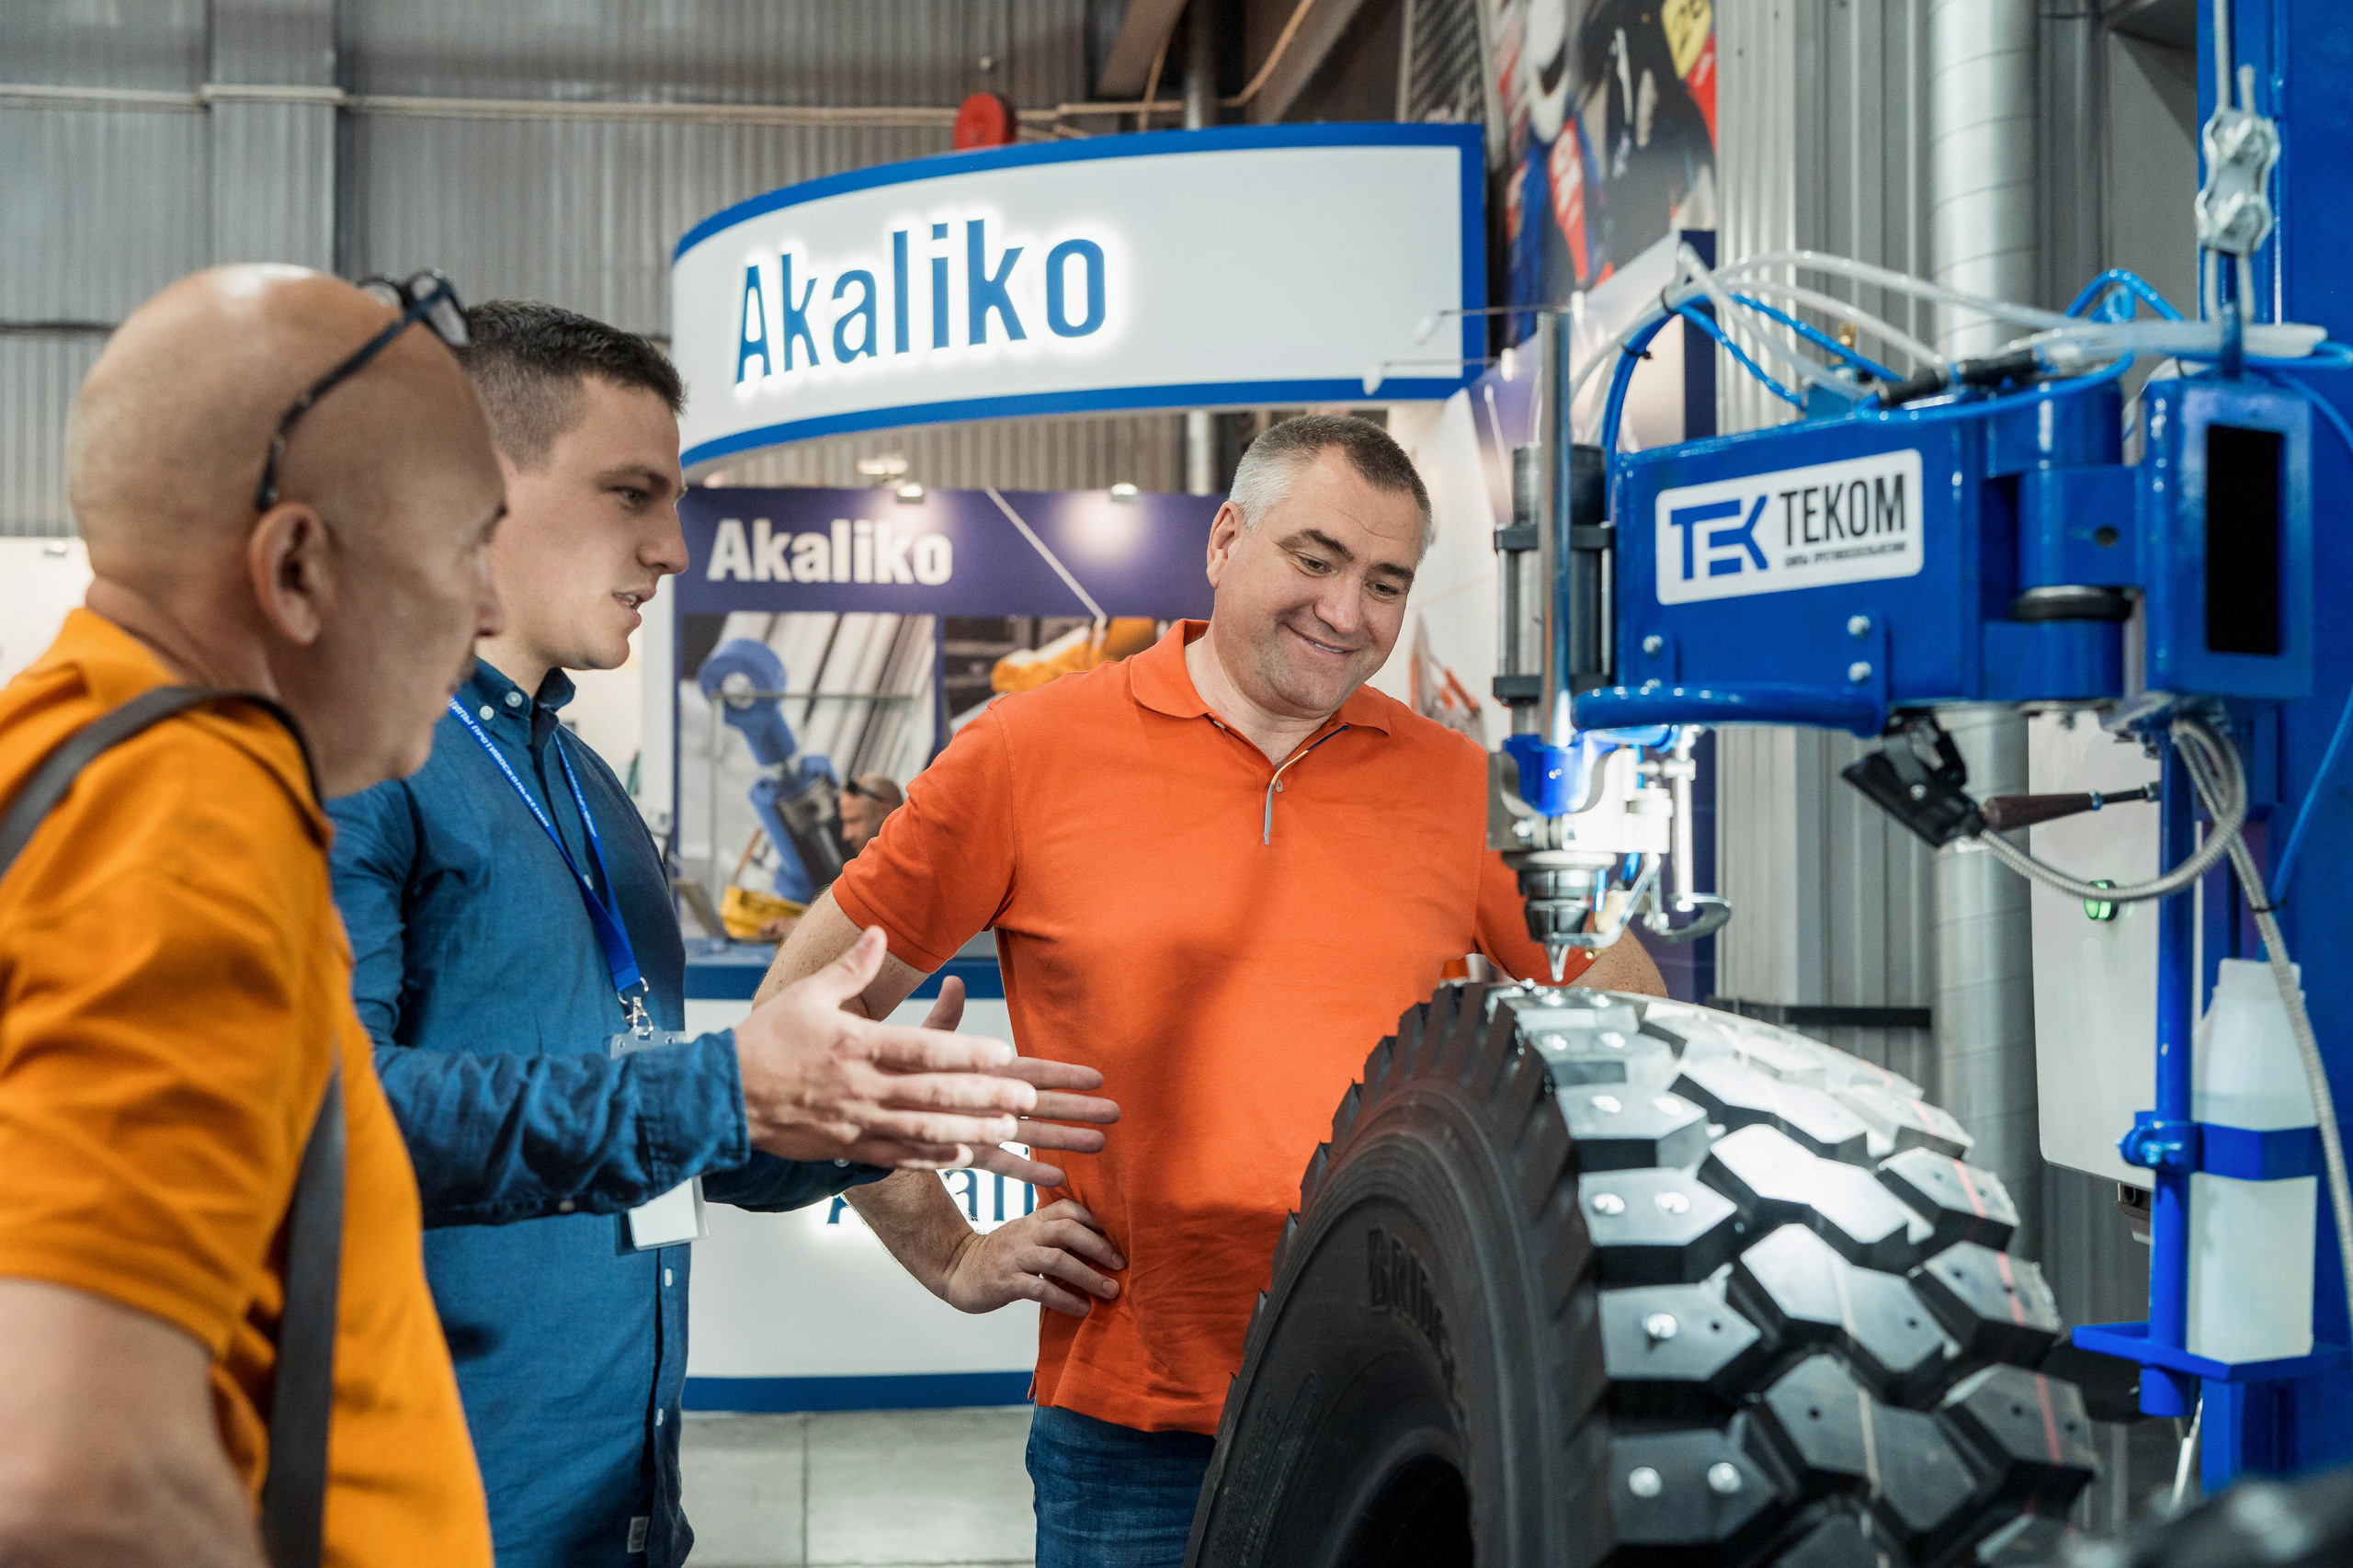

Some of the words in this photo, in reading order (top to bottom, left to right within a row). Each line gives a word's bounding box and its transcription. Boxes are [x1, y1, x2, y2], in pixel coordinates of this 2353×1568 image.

[735, 218, 1106, 384] Akaliko
[1779, 472, 1906, 547] TEKOM
[708, 518, 953, 585] Akaliko
